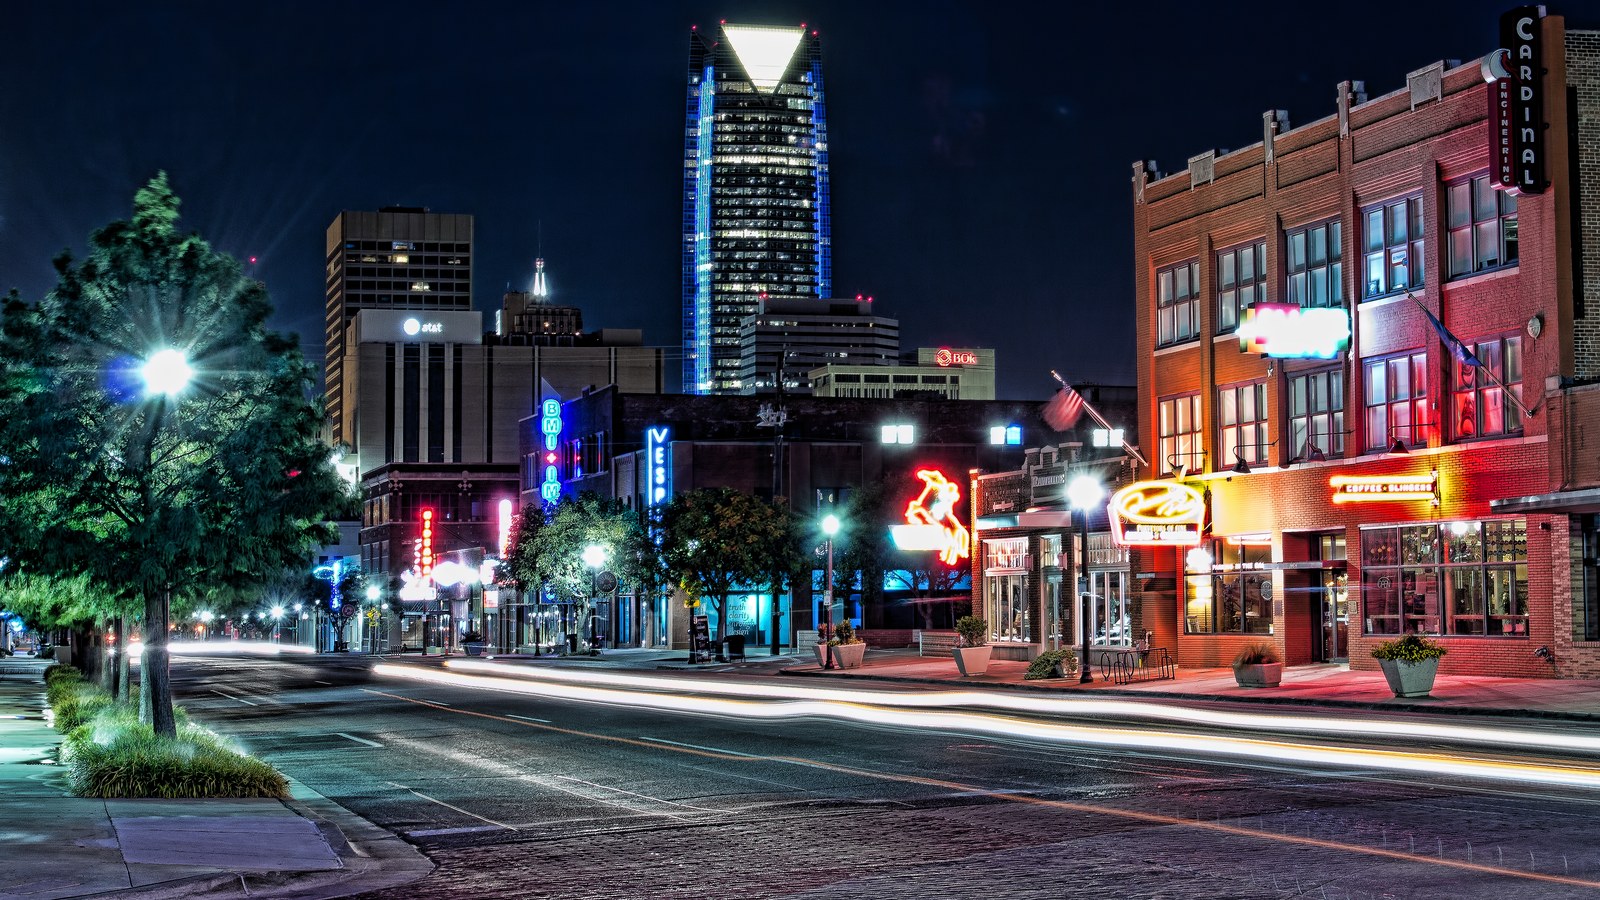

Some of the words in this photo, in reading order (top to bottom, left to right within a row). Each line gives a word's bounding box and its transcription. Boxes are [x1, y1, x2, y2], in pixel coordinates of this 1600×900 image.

[1500, 82, 1510, 183] ENGINEERING
[1516, 17, 1535, 186] CARDINAL
[542, 399, 562, 451] BMI
[728, 603, 746, 611] truth
